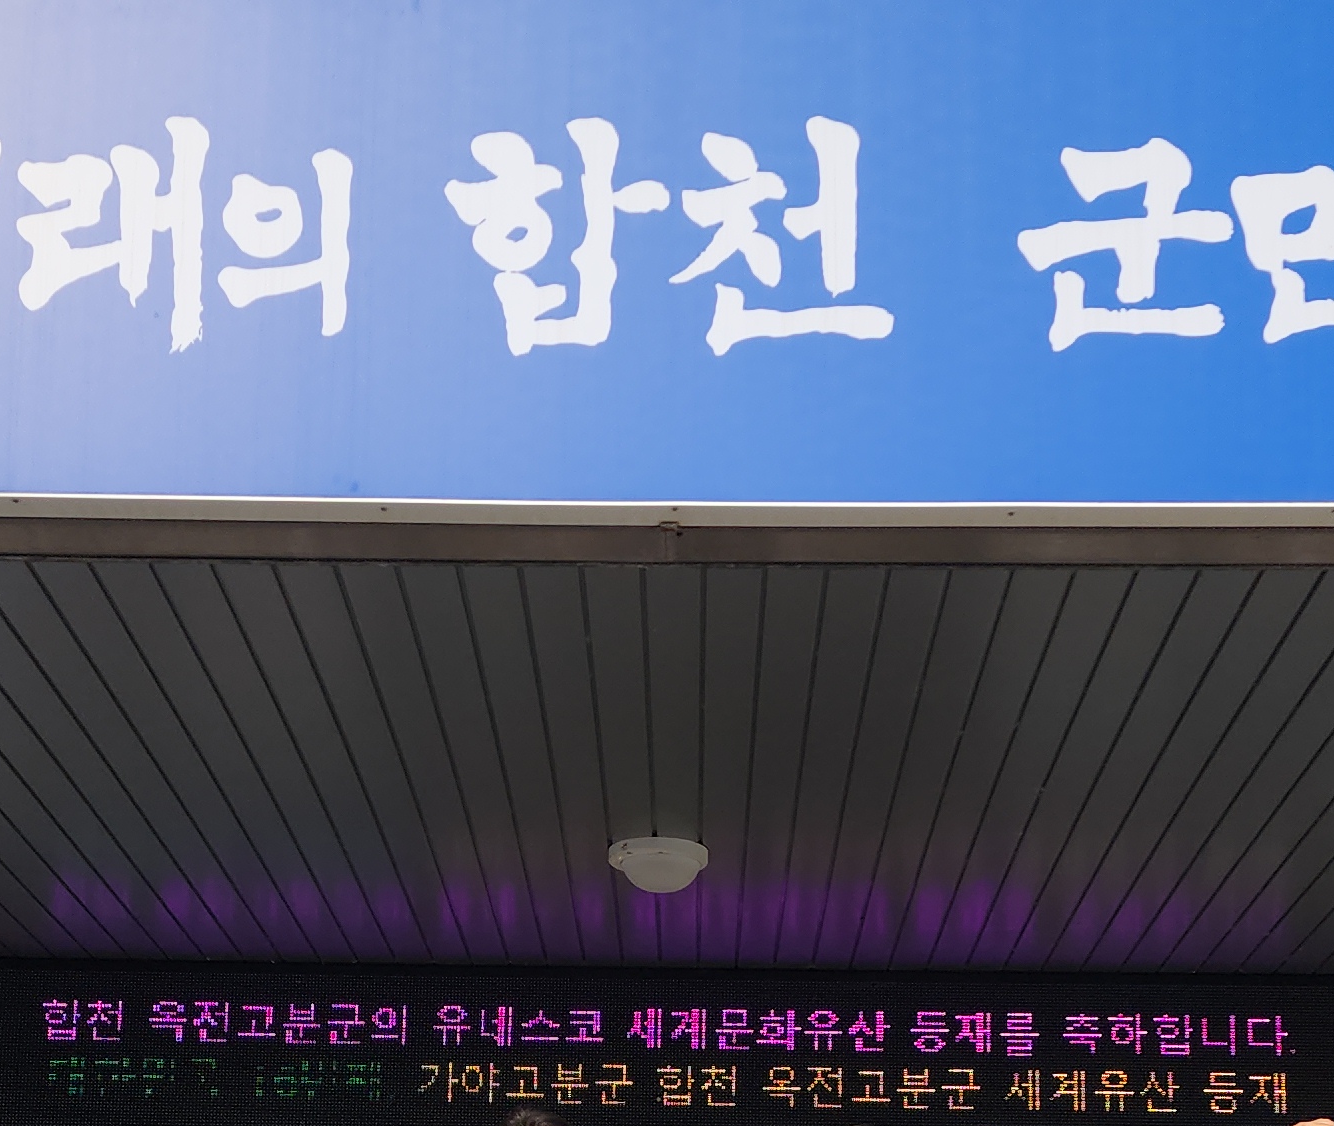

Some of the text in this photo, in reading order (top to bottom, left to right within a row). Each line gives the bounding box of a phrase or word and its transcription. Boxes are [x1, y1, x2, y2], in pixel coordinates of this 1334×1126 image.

[445, 116, 893, 356] 합천
[42, 999, 123, 1042] 합천
[148, 1000, 407, 1045] 옥전고분군의
[432, 1004, 604, 1047] 유네스코
[626, 1006, 891, 1053] 세계문화유산
[910, 1010, 1039, 1056] 등재를
[1062, 1012, 1296, 1056] 축하합니다.
[419, 1061, 633, 1106] 가야고분군
[657, 1065, 737, 1107] 합천
[762, 1065, 980, 1112] 옥전고분군
[1005, 1068, 1180, 1114] 세계유산
[1203, 1071, 1288, 1115] 등재
